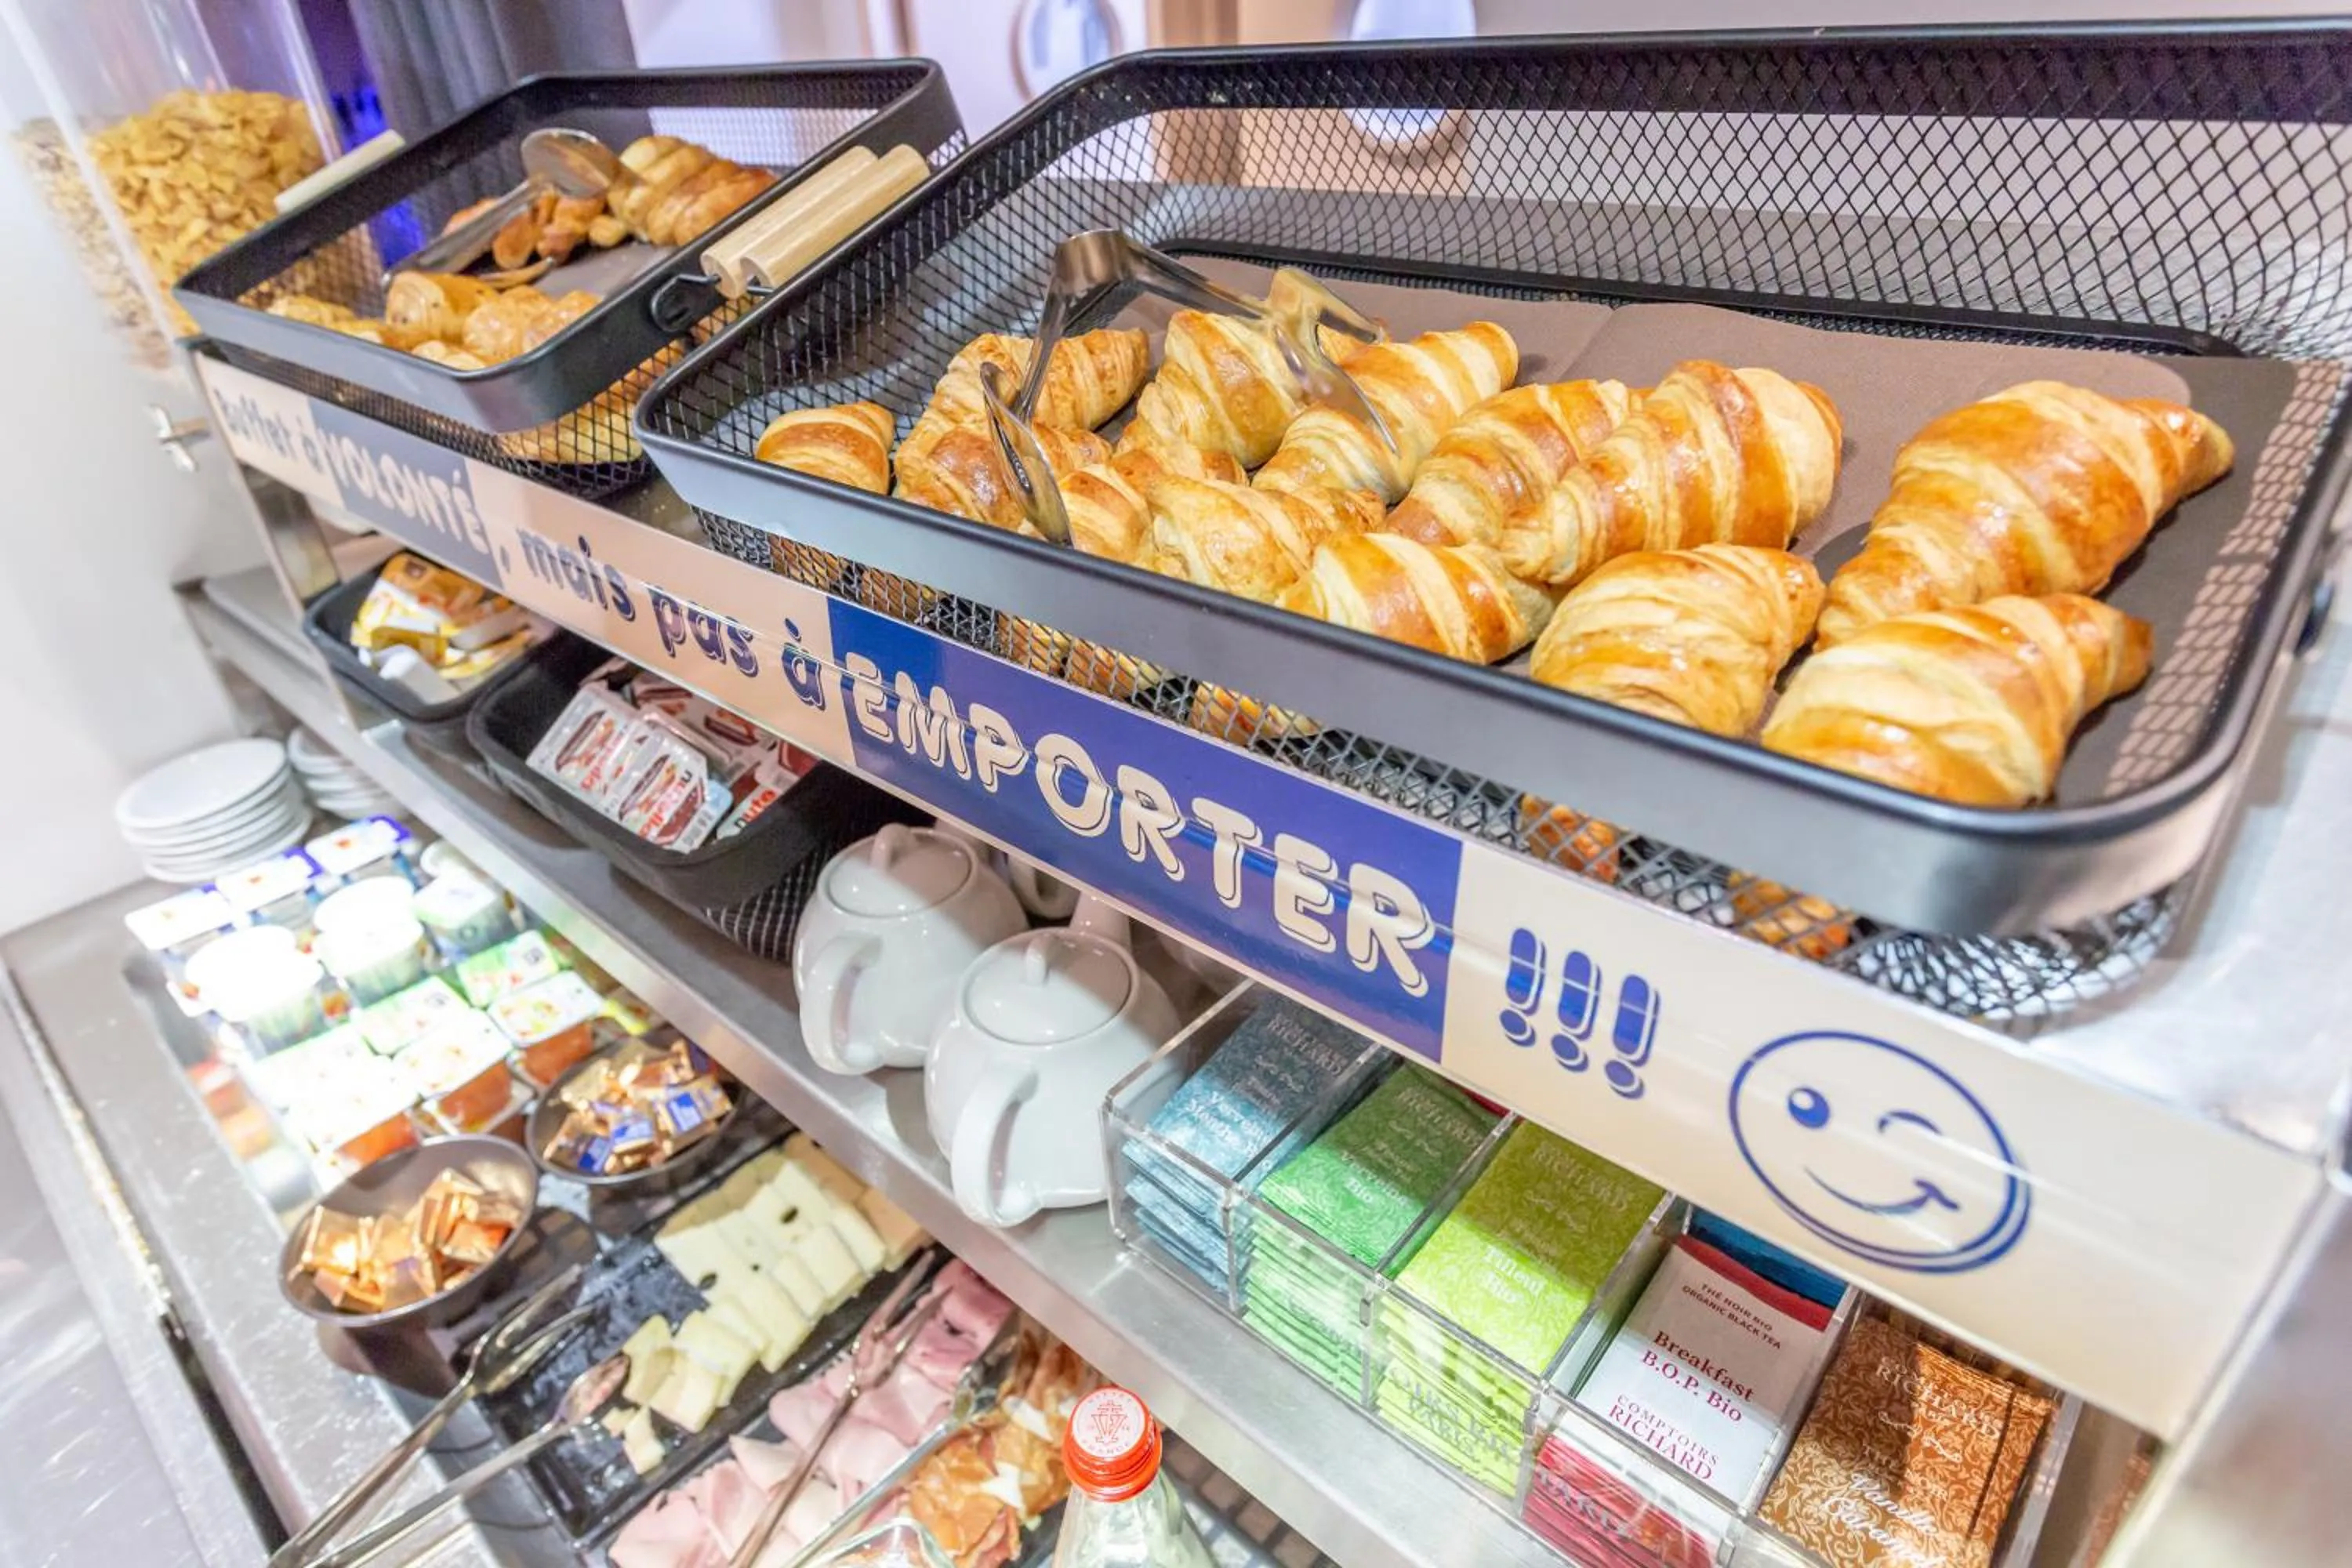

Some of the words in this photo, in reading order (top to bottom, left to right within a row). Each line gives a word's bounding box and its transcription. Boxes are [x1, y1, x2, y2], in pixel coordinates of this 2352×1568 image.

[517, 529, 635, 622] mais
[648, 585, 758, 678] pas
[782, 618, 826, 710] à
[845, 650, 1436, 1000] EMPORTER
[1498, 927, 1661, 1099] !!!
[1344, 1176, 1373, 1203] Bio
[1682, 1285, 1726, 1316] ORGANIC
[1728, 1311, 1759, 1337] BLACK
[1762, 1333, 1781, 1349] TEA
[1725, 1296, 1751, 1317] NOIR
[1753, 1315, 1773, 1331] BIO
[1642, 1350, 1699, 1396] B.O.P.
[1706, 1390, 1742, 1422] Bio
[1653, 1330, 1755, 1403] Breakfast
[1875, 1363, 2001, 1438] RICHARD
[1608, 1404, 1712, 1480] RICHARD
[1617, 1394, 1719, 1465] COMPTOIRS
